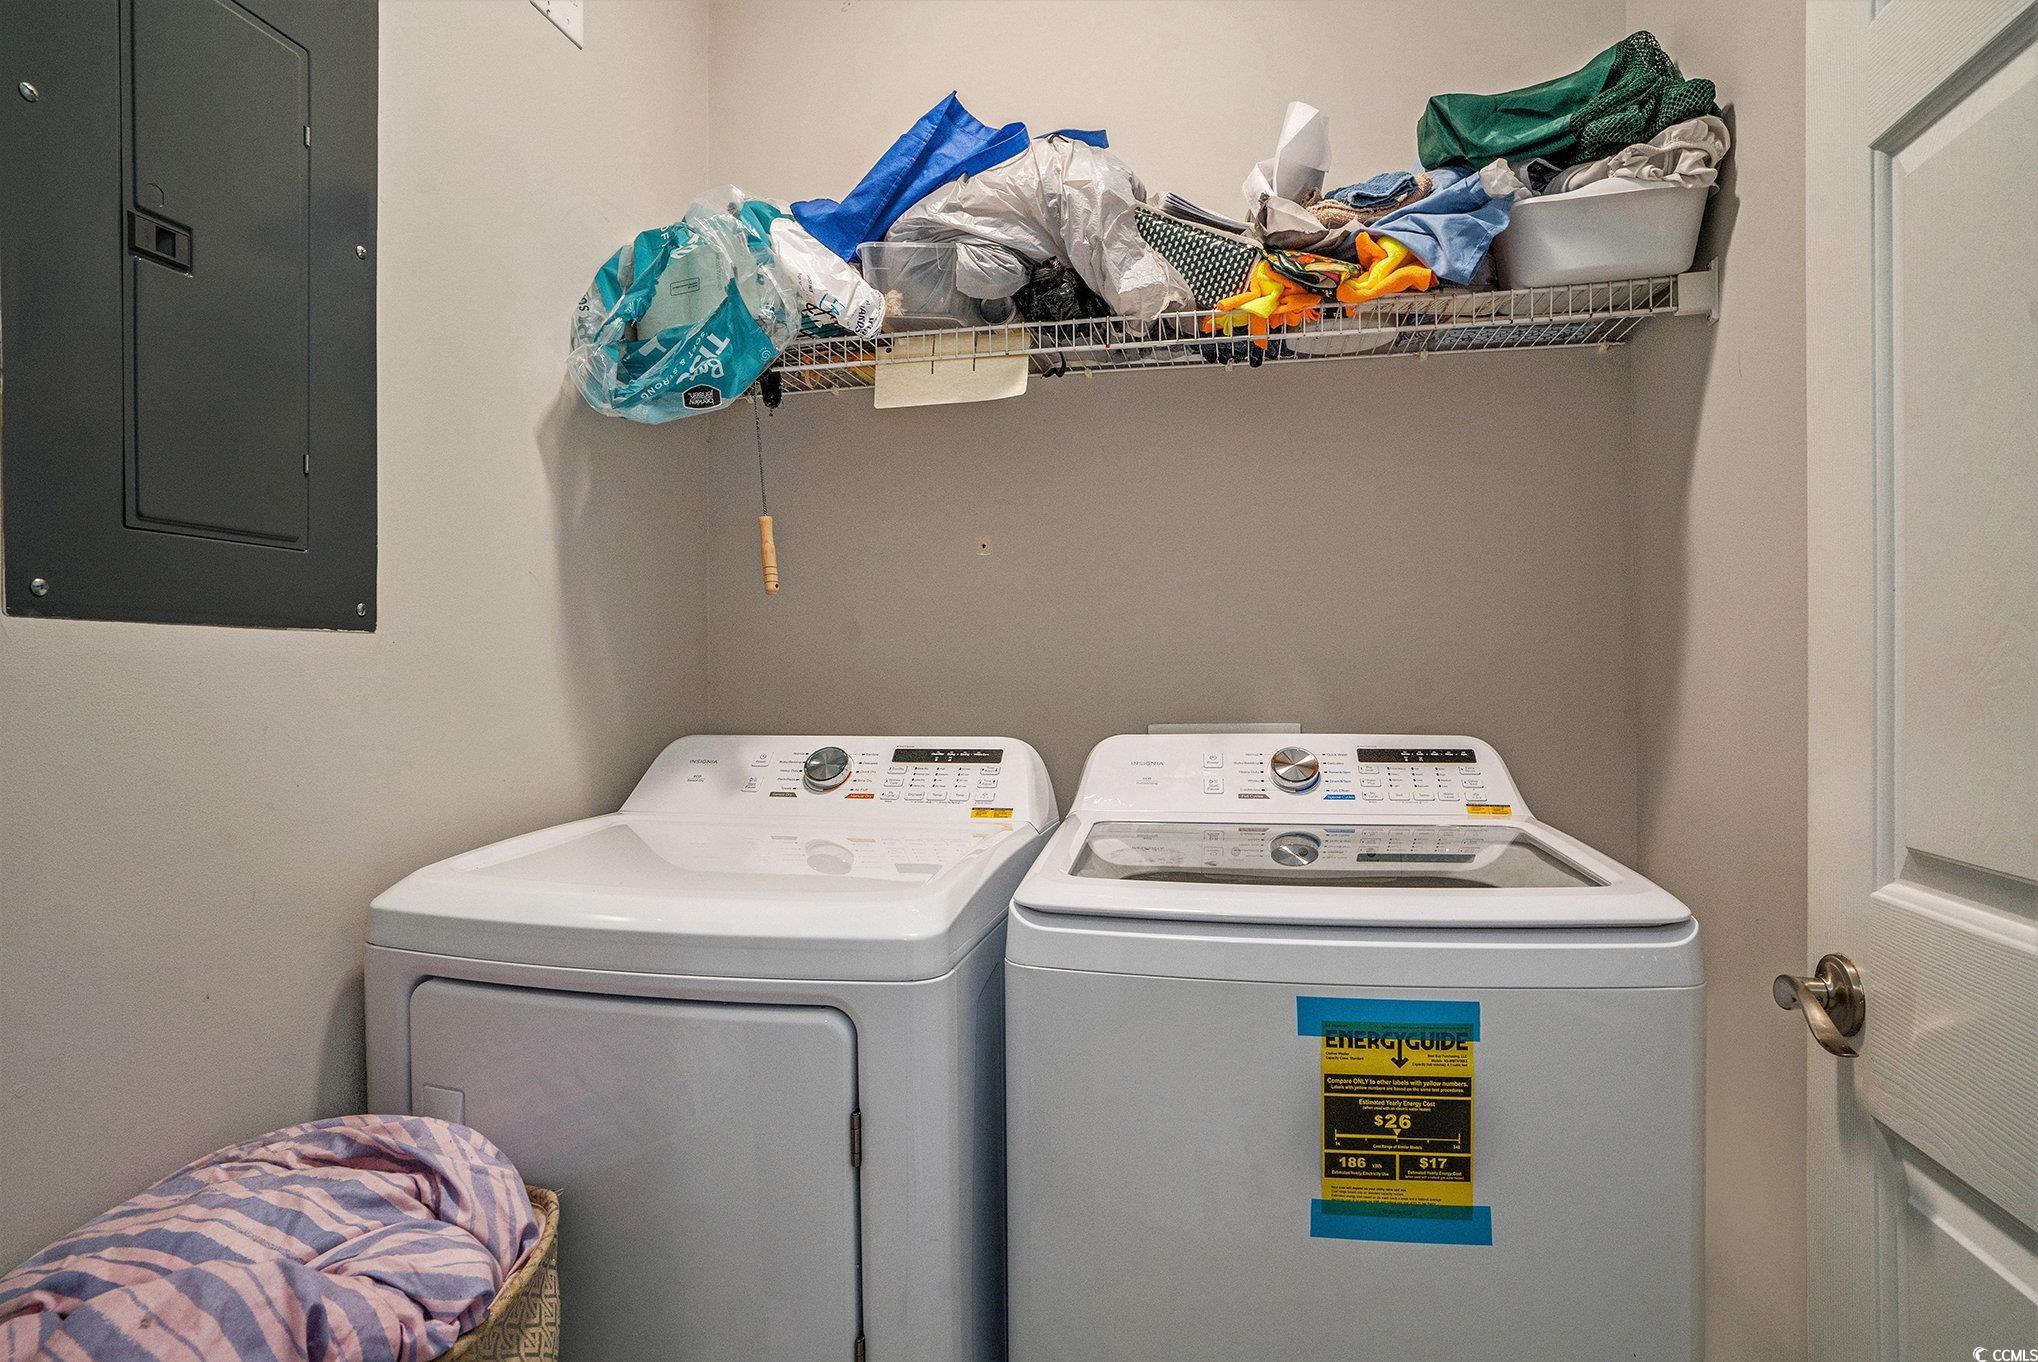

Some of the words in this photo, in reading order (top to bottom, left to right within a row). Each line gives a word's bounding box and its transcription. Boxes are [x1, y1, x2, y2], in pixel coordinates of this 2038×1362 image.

[640, 368, 679, 399] STRONG
[1326, 1077, 1352, 1085] Compare
[1374, 1114, 1412, 1129] $26
[1339, 1156, 1366, 1168] 186
[1419, 1157, 1448, 1170] $17
